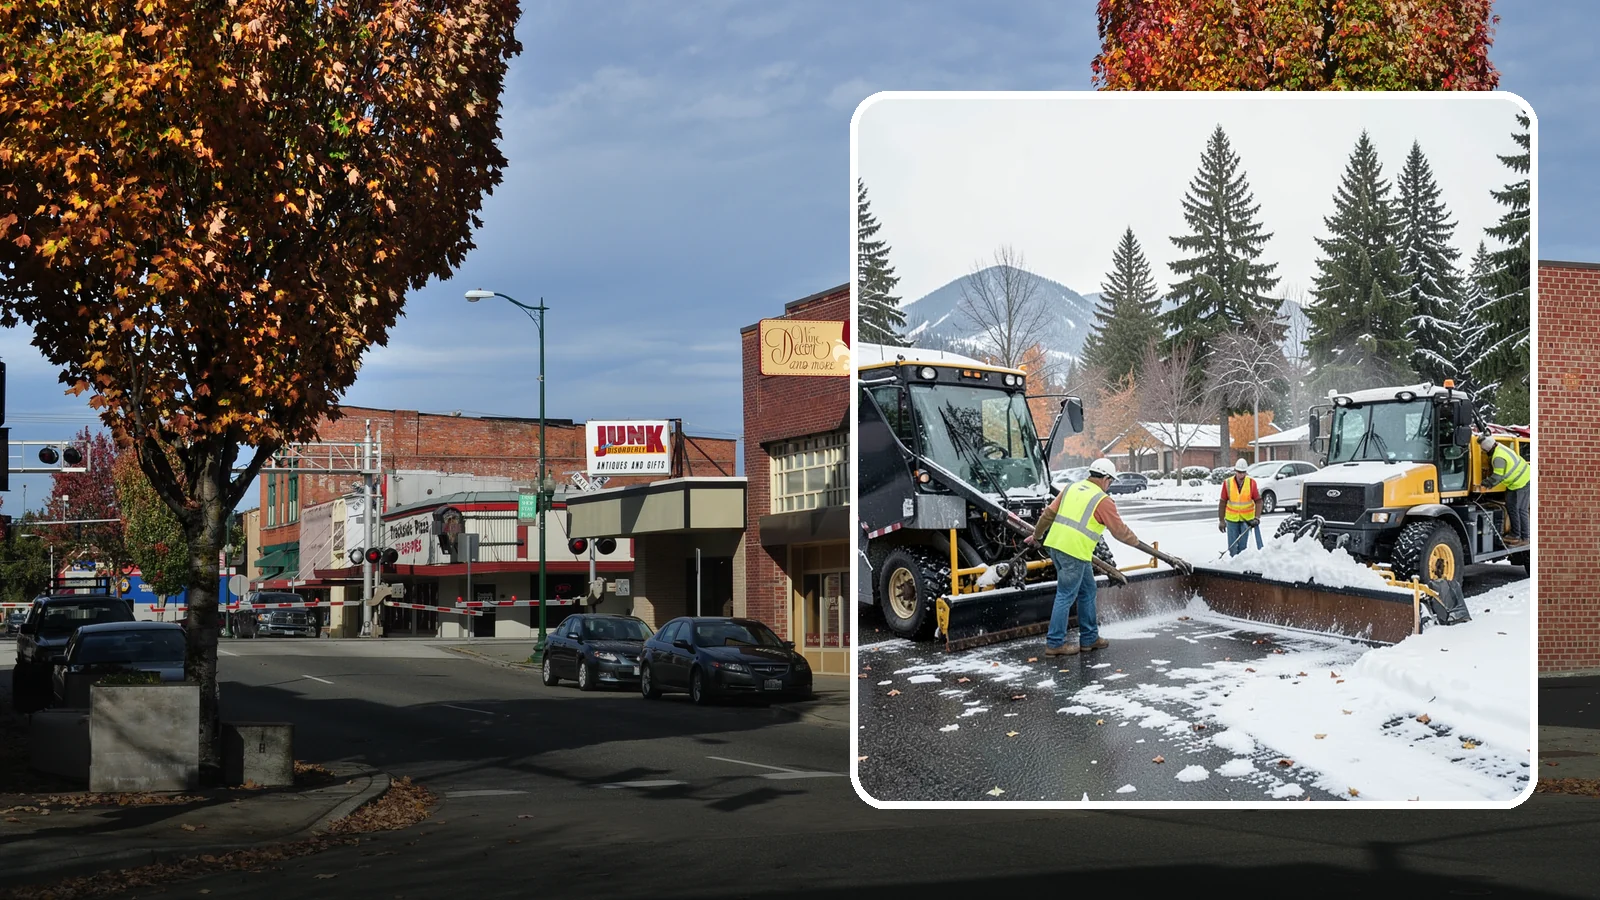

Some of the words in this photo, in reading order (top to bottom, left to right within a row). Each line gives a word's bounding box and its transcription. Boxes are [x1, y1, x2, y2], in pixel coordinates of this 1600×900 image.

[765, 327, 831, 366] Decor
[595, 425, 665, 457] JUNK
[607, 446, 646, 454] DISORDERLY
[596, 461, 628, 470] ANTIQUES
[631, 461, 644, 470] AND
[646, 460, 665, 470] GIFTS
[572, 473, 589, 493] RAIL
[390, 521, 413, 540] Trackside
[414, 519, 429, 535] Pizza
